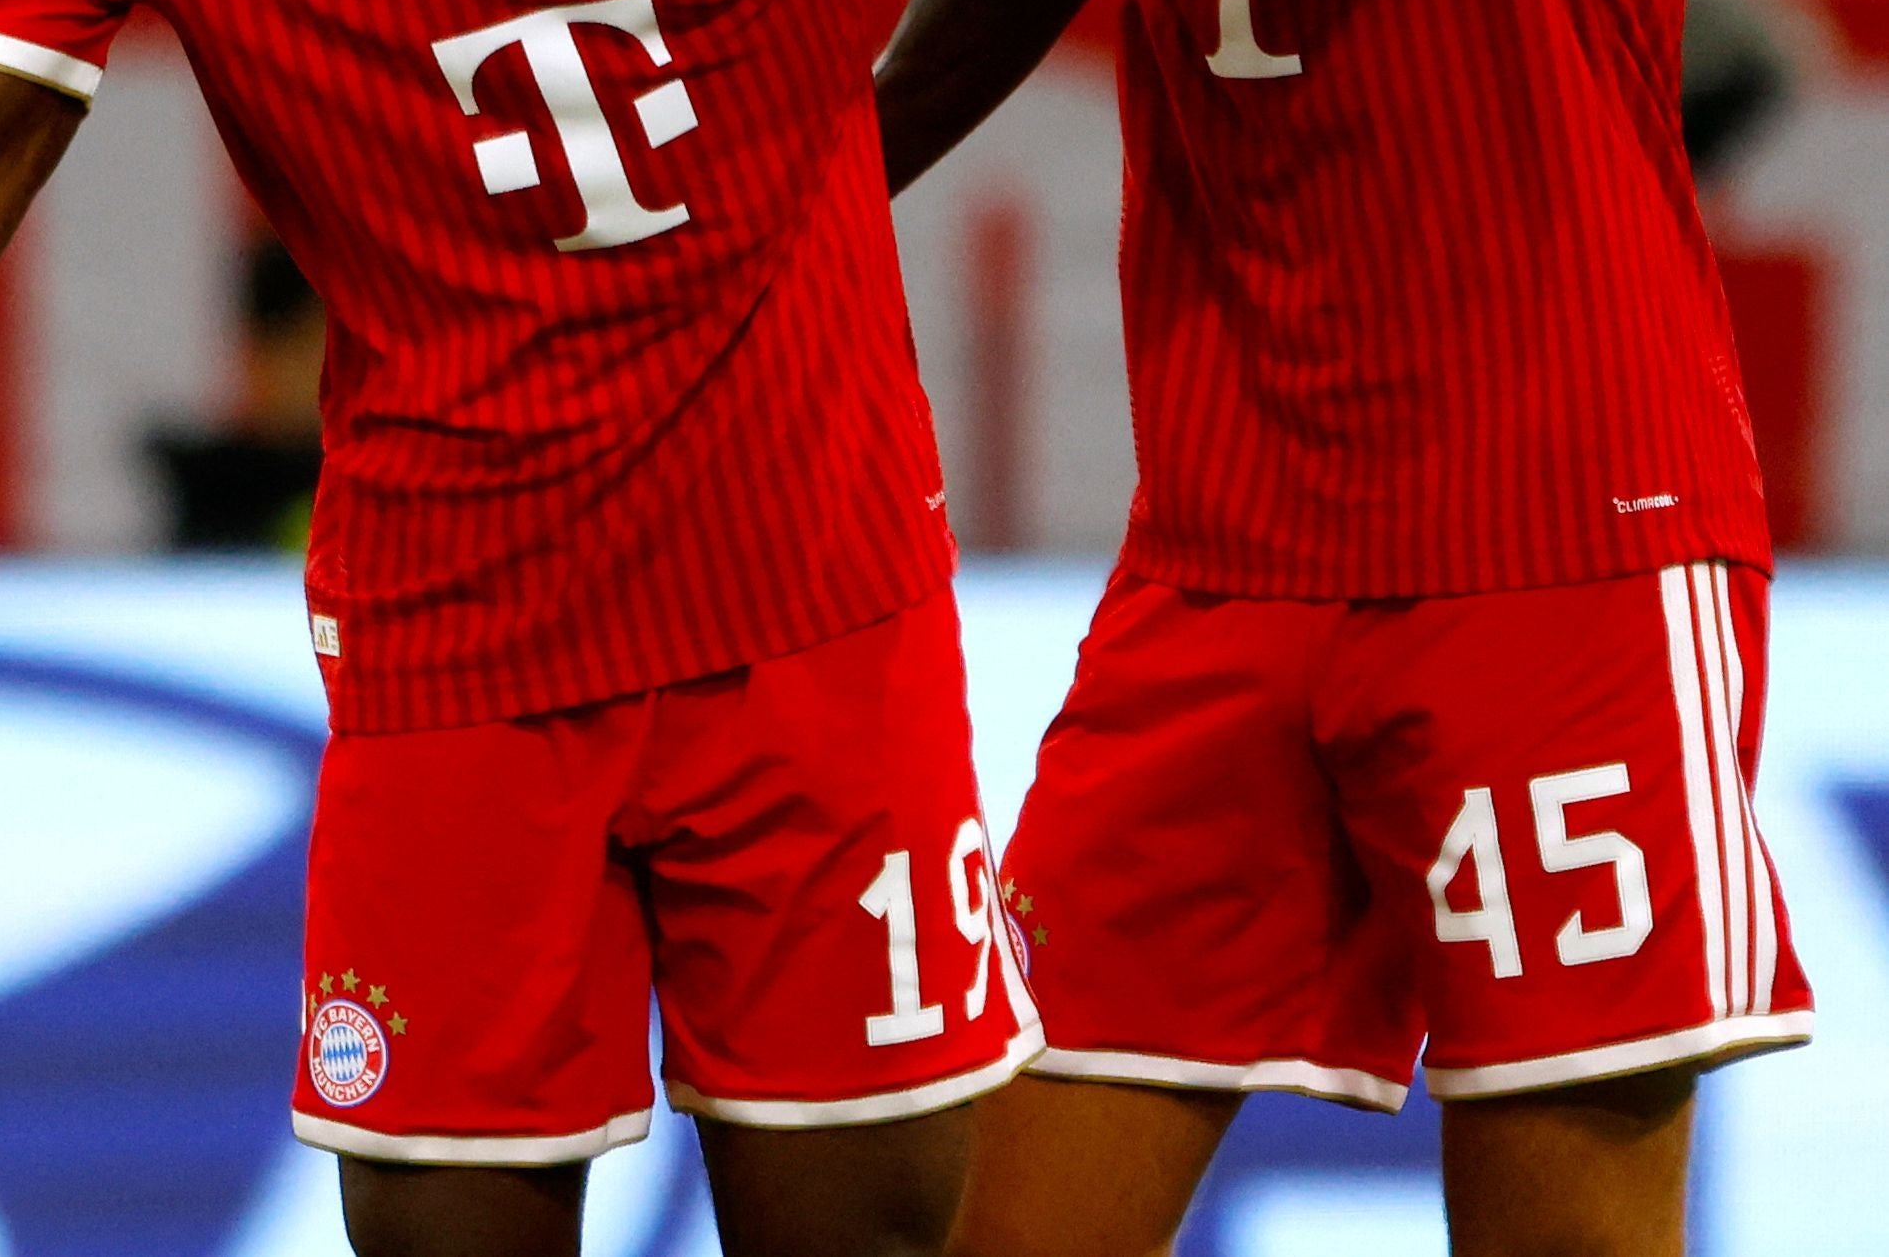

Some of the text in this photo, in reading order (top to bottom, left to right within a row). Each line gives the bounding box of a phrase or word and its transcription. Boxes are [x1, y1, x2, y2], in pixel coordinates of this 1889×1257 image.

[1616, 494, 1675, 513] CLIMACOOL
[858, 817, 992, 1047] 19
[1426, 763, 1653, 979] 45
[329, 1007, 380, 1052] BAYERN
